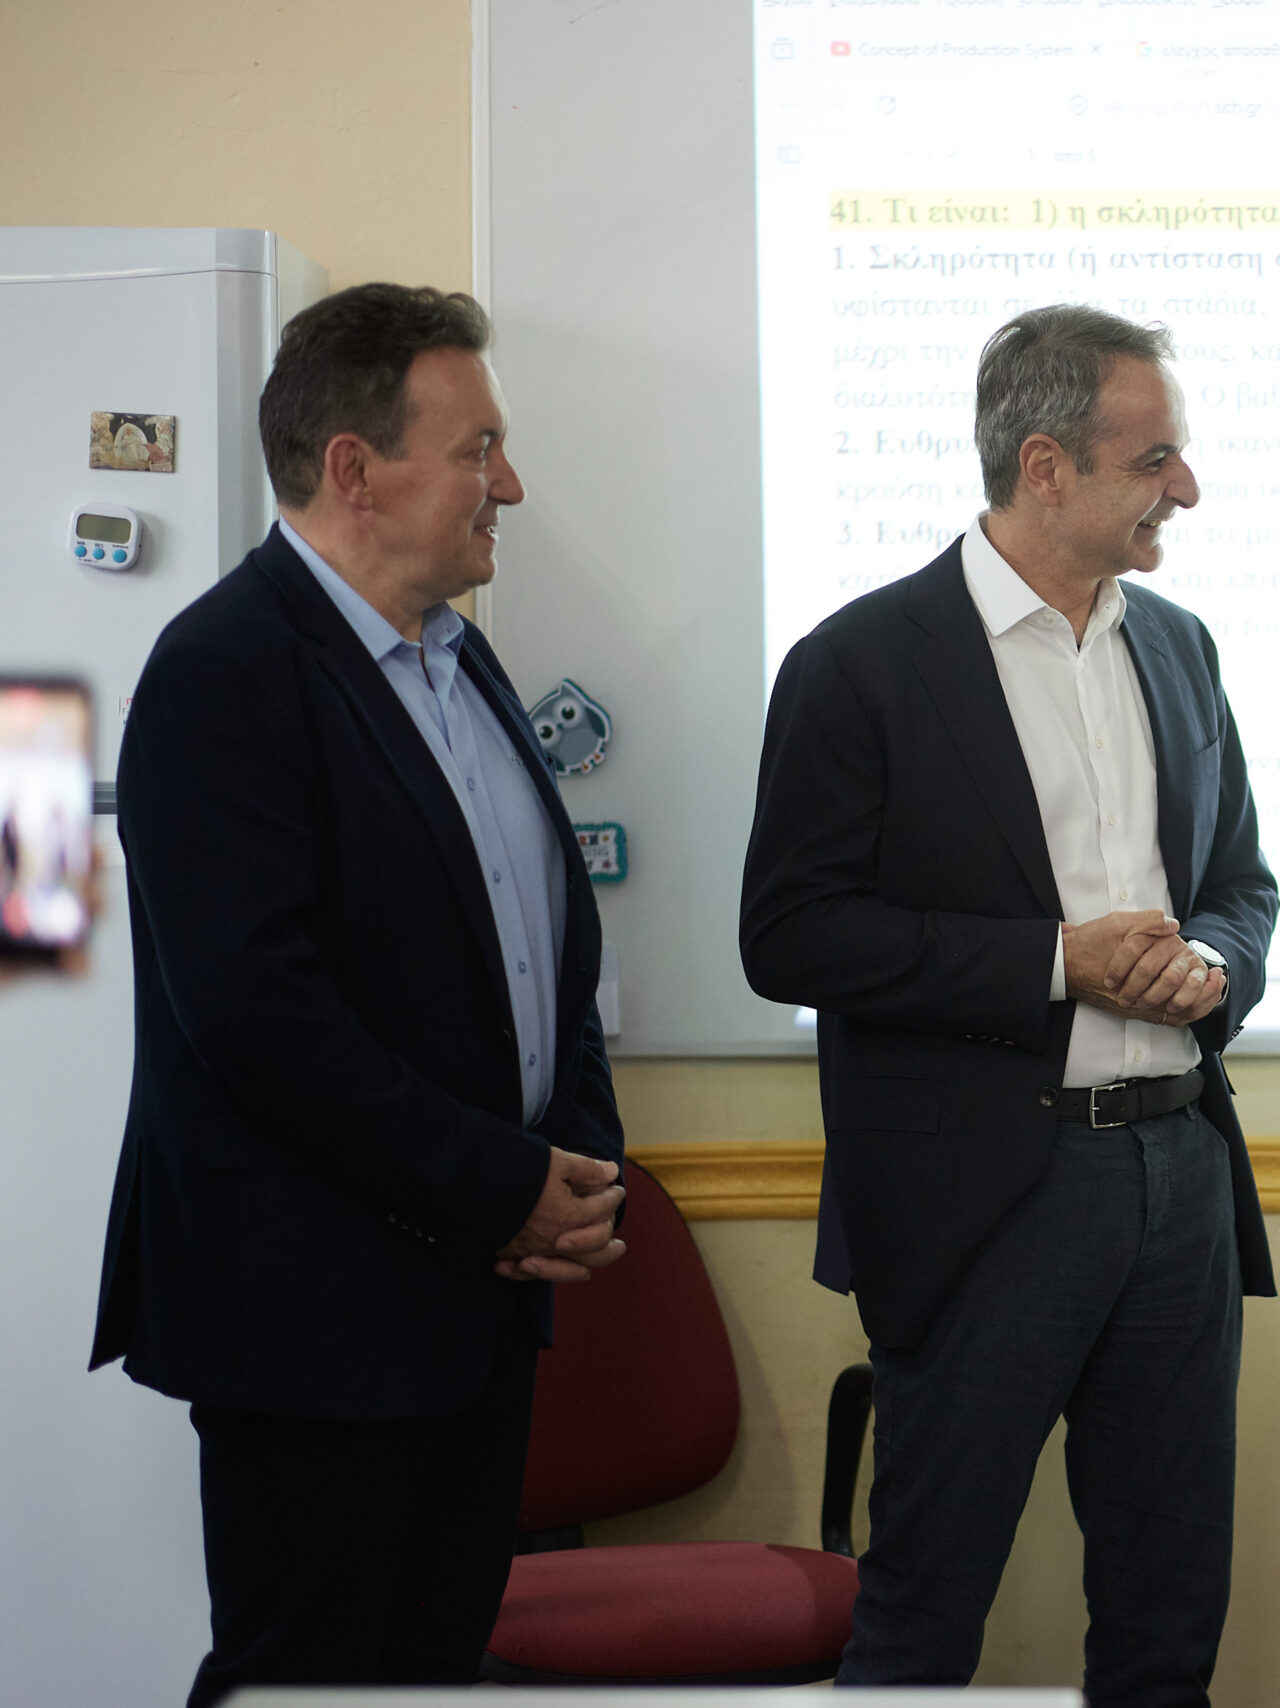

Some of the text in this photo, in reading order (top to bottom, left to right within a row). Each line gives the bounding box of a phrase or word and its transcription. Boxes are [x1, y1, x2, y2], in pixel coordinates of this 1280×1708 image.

[858, 42, 1076, 61] Concept of Production System
[830, 199, 873, 225] 41.
[883, 199, 917, 225] Τι
[927, 197, 1010, 225] είναι:
[1032, 198, 1059, 229] 1)
[1068, 205, 1087, 230] η
[832, 245, 856, 271] 1.
[870, 244, 1056, 277] Σκληρότητα
[1068, 244, 1098, 277] (ή
[1109, 245, 1264, 278] αντίσταση
[831, 290, 990, 320] υφίστανται
[832, 336, 909, 369] μέχρι
[834, 429, 860, 455] 2.
[875, 429, 977, 461] Ευθρυ
[835, 519, 862, 545] 3.
